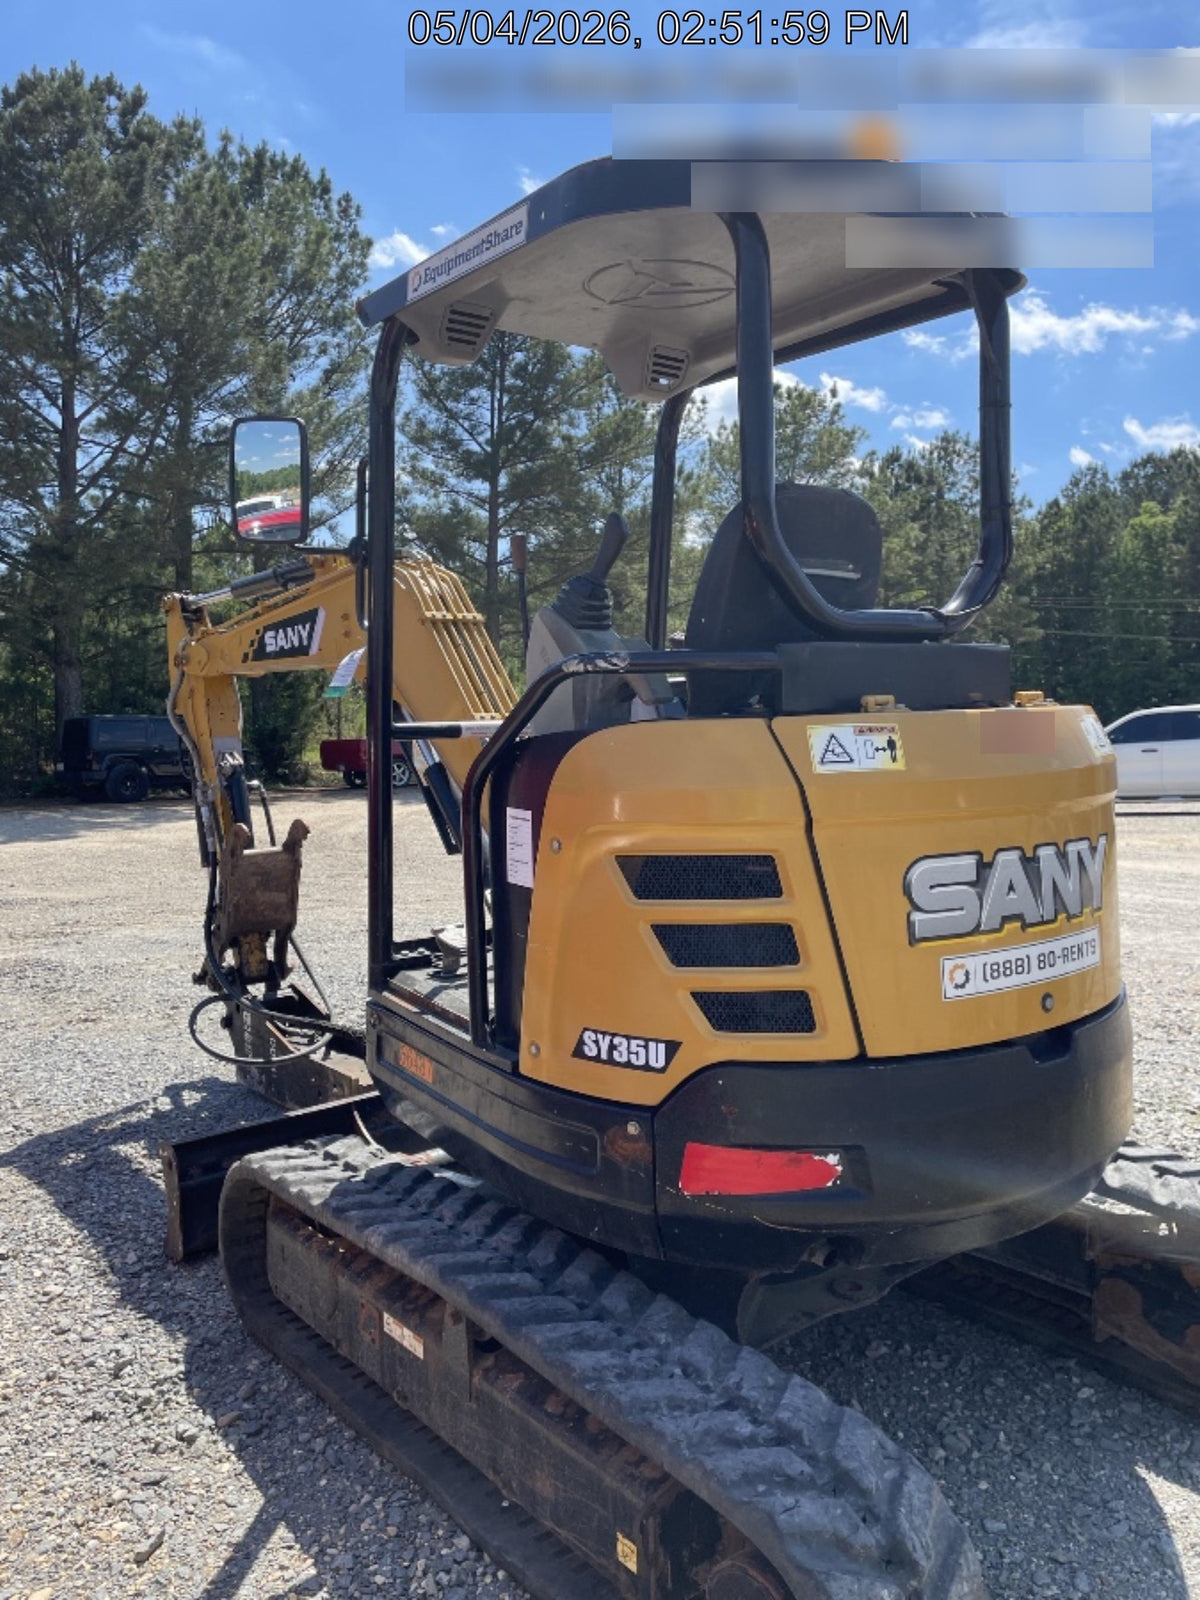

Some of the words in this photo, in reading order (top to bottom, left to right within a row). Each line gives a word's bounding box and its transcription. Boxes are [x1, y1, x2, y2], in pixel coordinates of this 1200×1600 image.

[423, 220, 524, 285] EquipmentShare
[264, 622, 311, 653] SANY
[903, 833, 1108, 946] SANY
[982, 953, 1032, 983] (888)
[1037, 937, 1097, 970] 80-RENTS
[582, 1030, 666, 1069] SY35U
